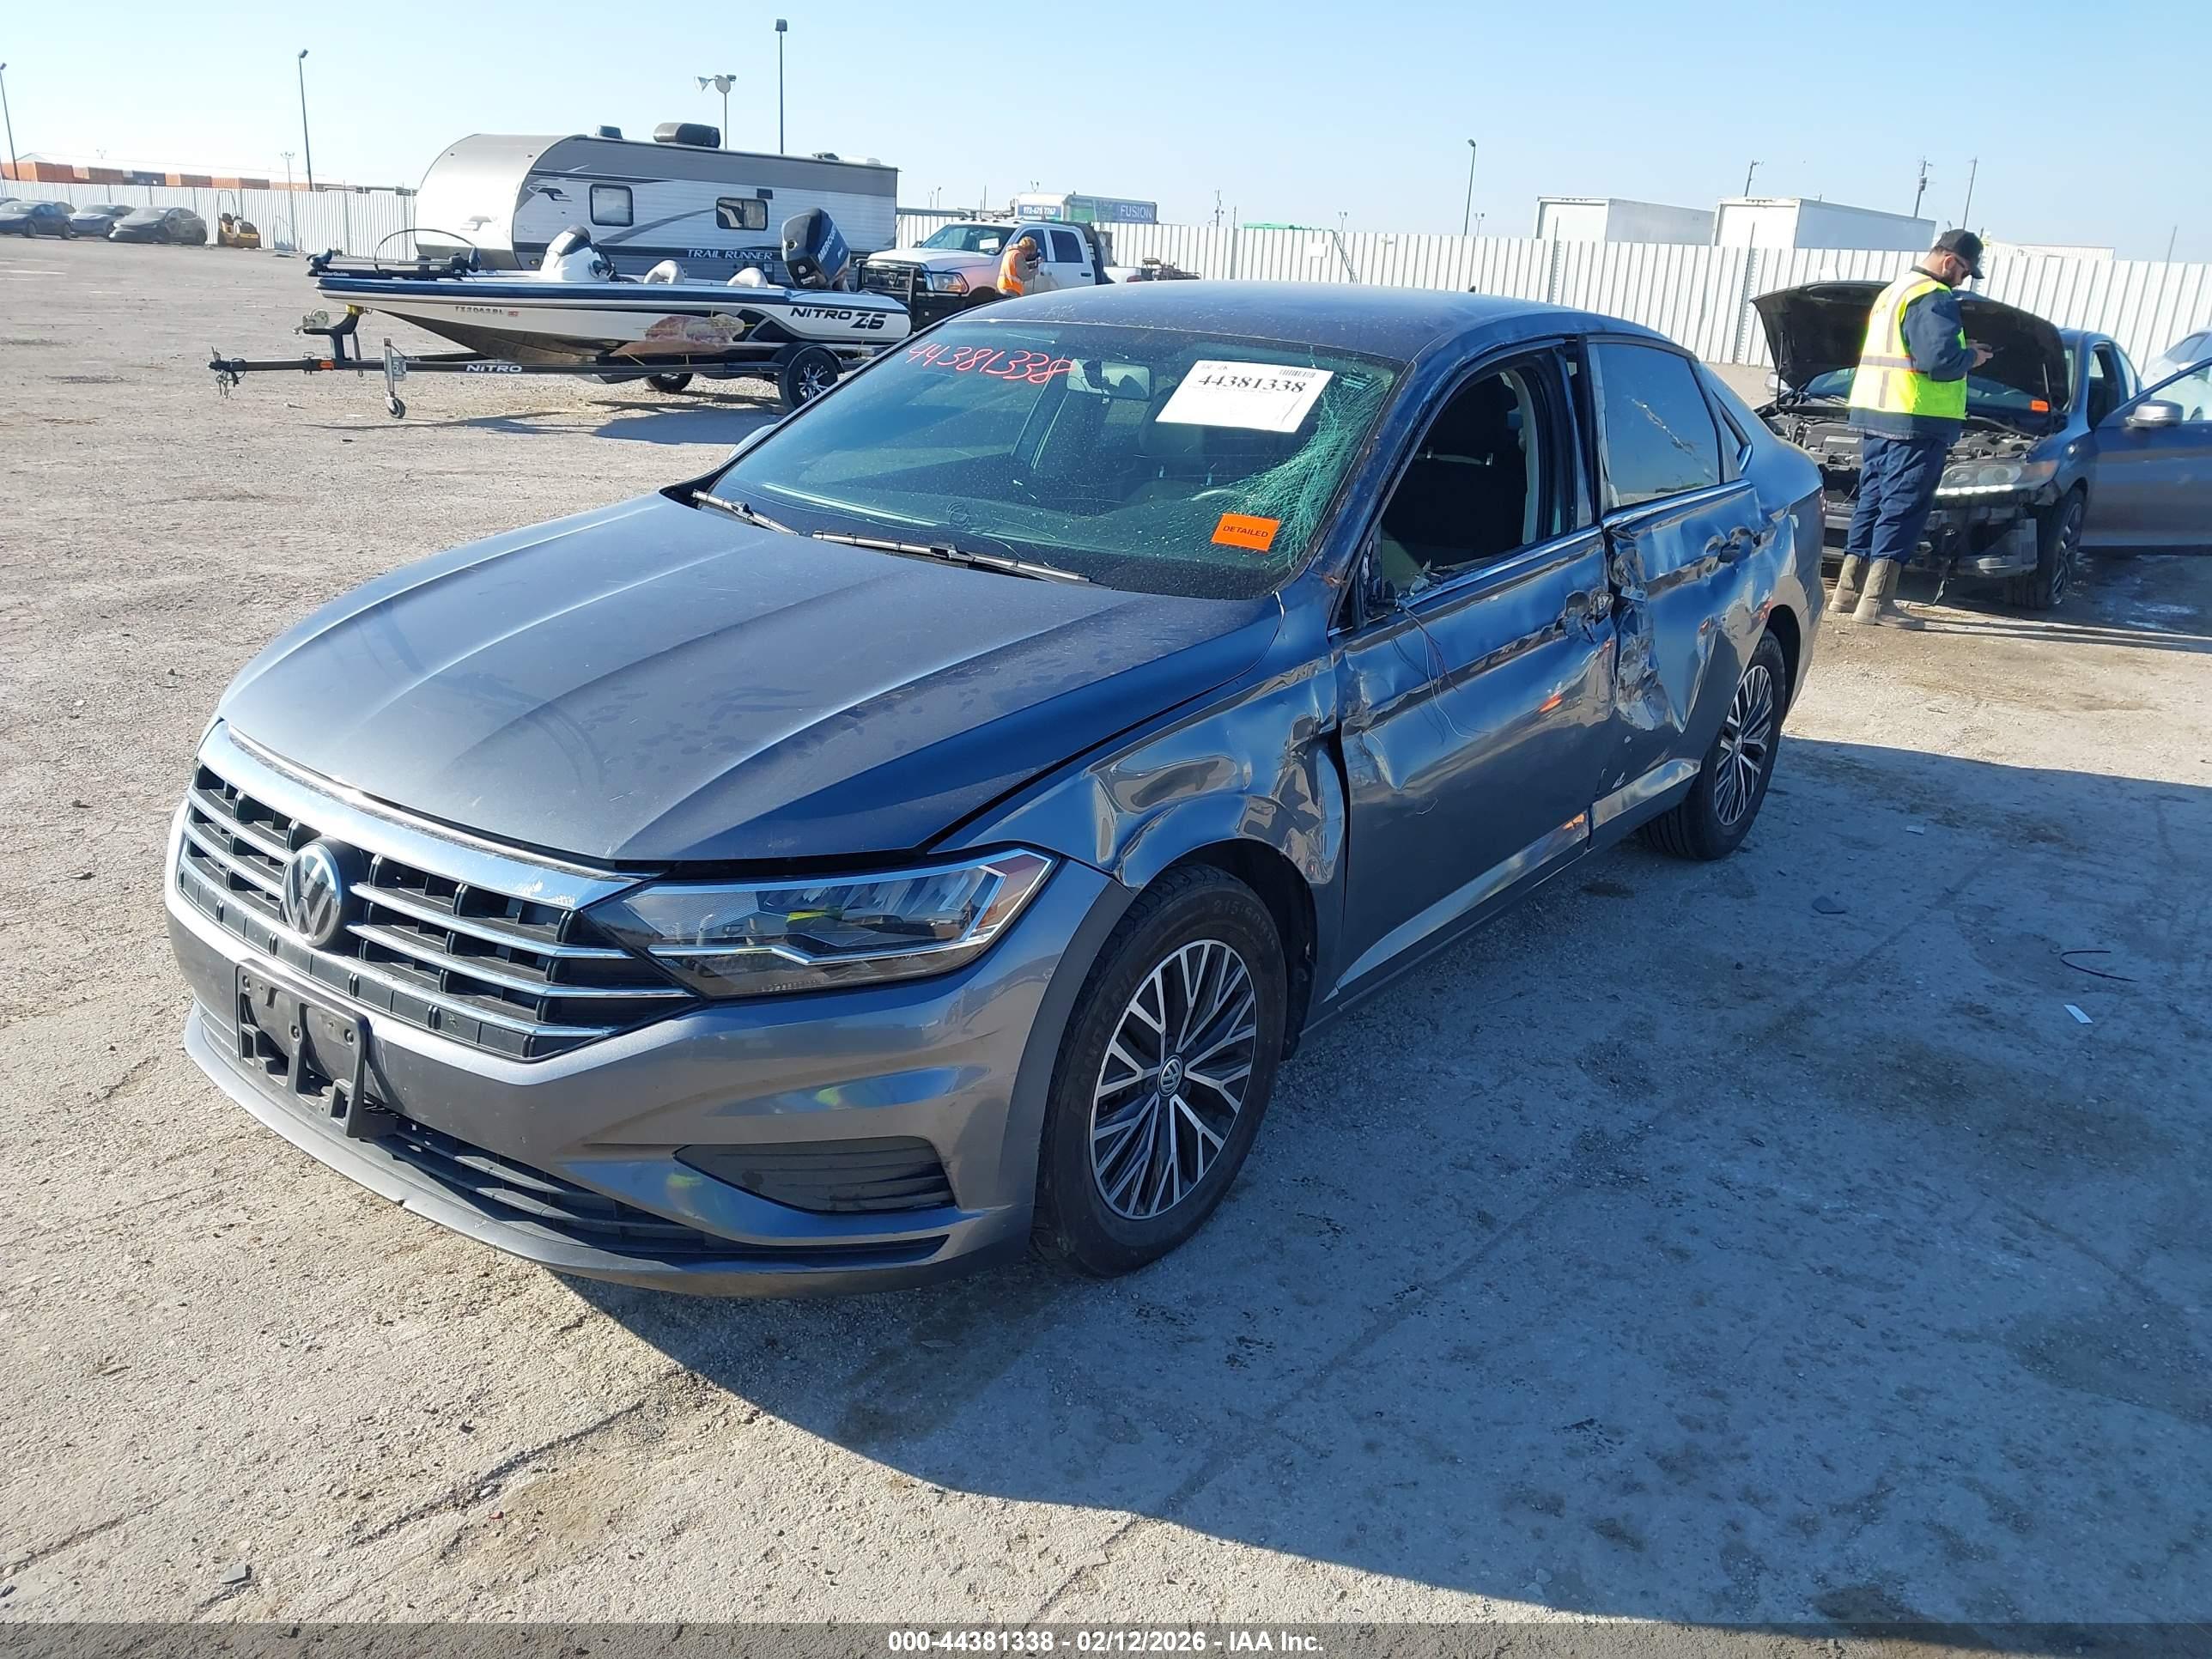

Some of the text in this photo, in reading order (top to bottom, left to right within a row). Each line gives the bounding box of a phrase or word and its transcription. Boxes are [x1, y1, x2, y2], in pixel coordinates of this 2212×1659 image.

[1120, 204, 1153, 220] FUSION
[688, 249, 773, 260] TRAIL RUNNER
[790, 307, 853, 320] NITRO
[905, 340, 1075, 384] 44381338
[1198, 374, 1307, 393] 44381338
[1223, 526, 1269, 538] DETAILED
